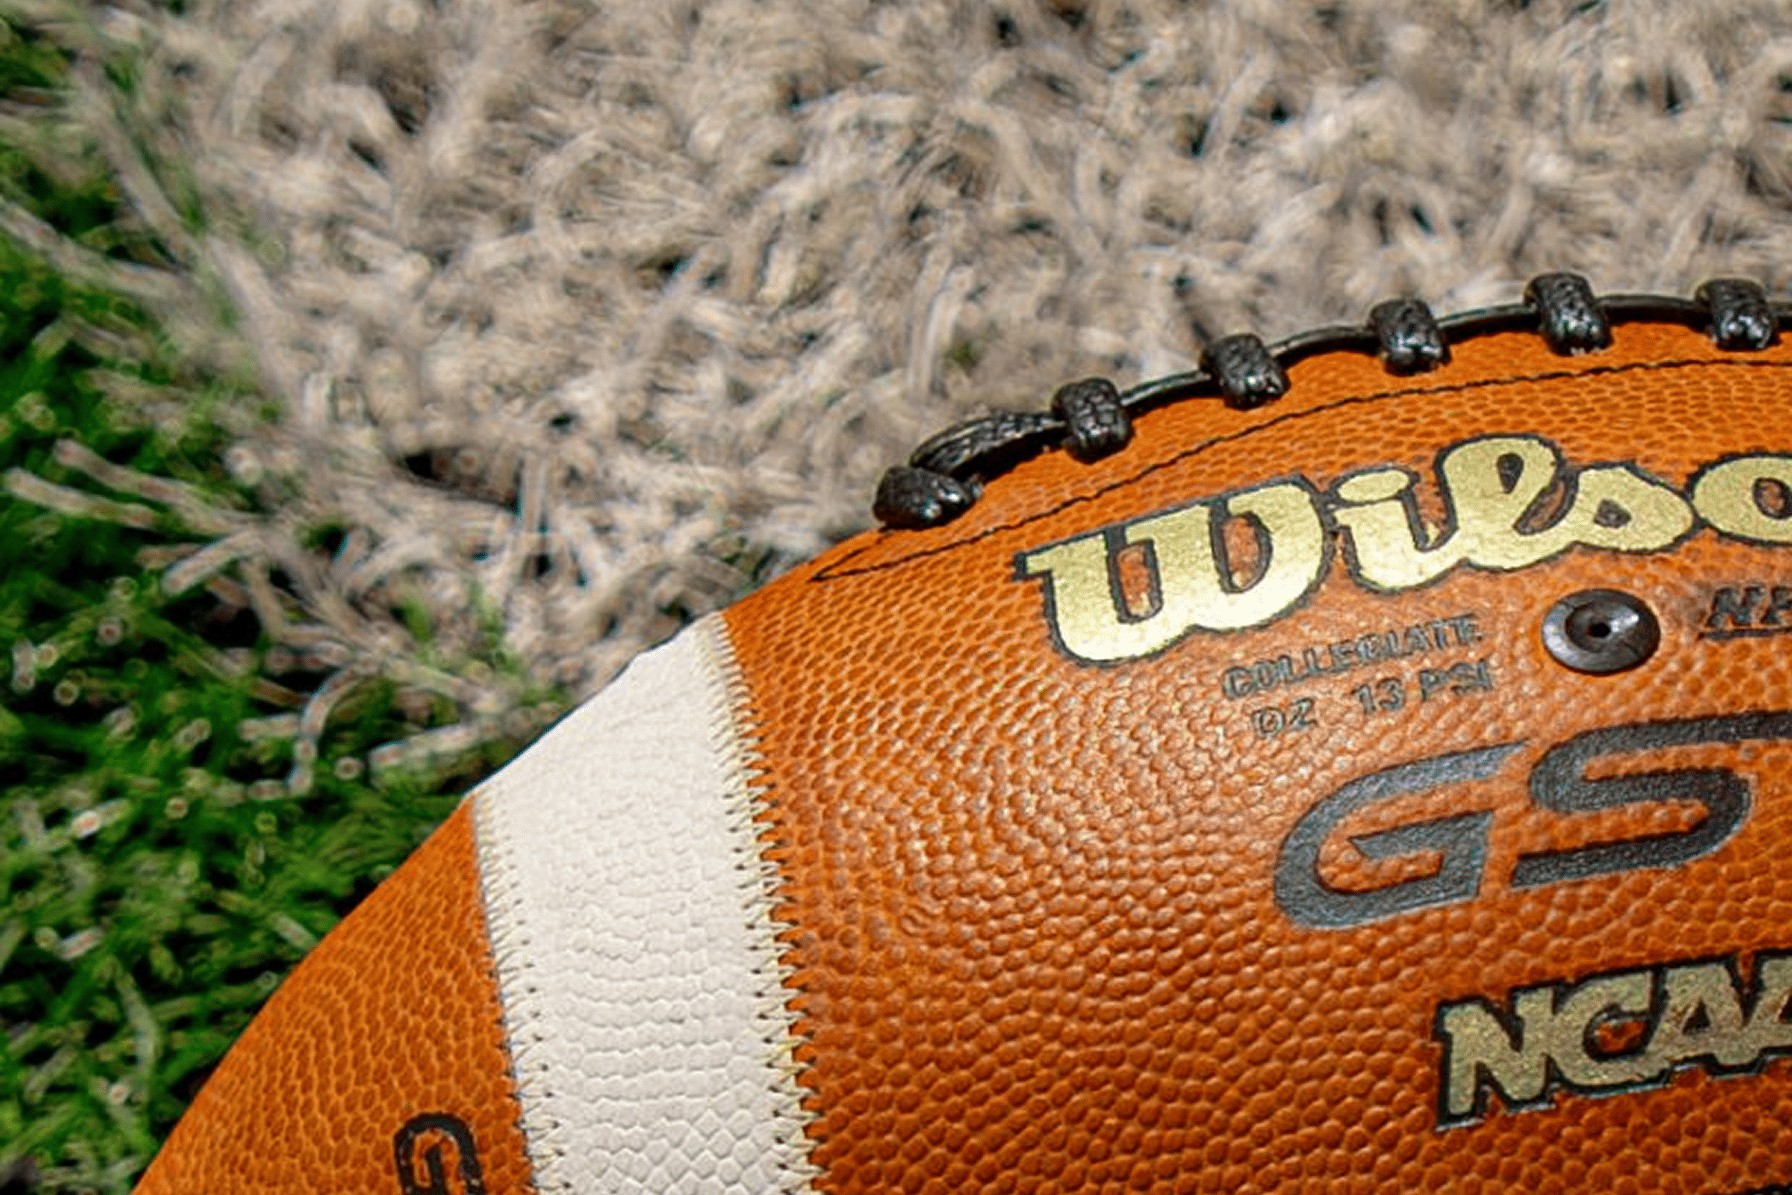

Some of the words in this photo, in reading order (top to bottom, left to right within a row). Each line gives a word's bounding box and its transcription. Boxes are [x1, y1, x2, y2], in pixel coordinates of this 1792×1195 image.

[1222, 612, 1482, 700] COLLEGIATE
[1352, 677, 1405, 715] 13
[1418, 658, 1493, 702] PSI
